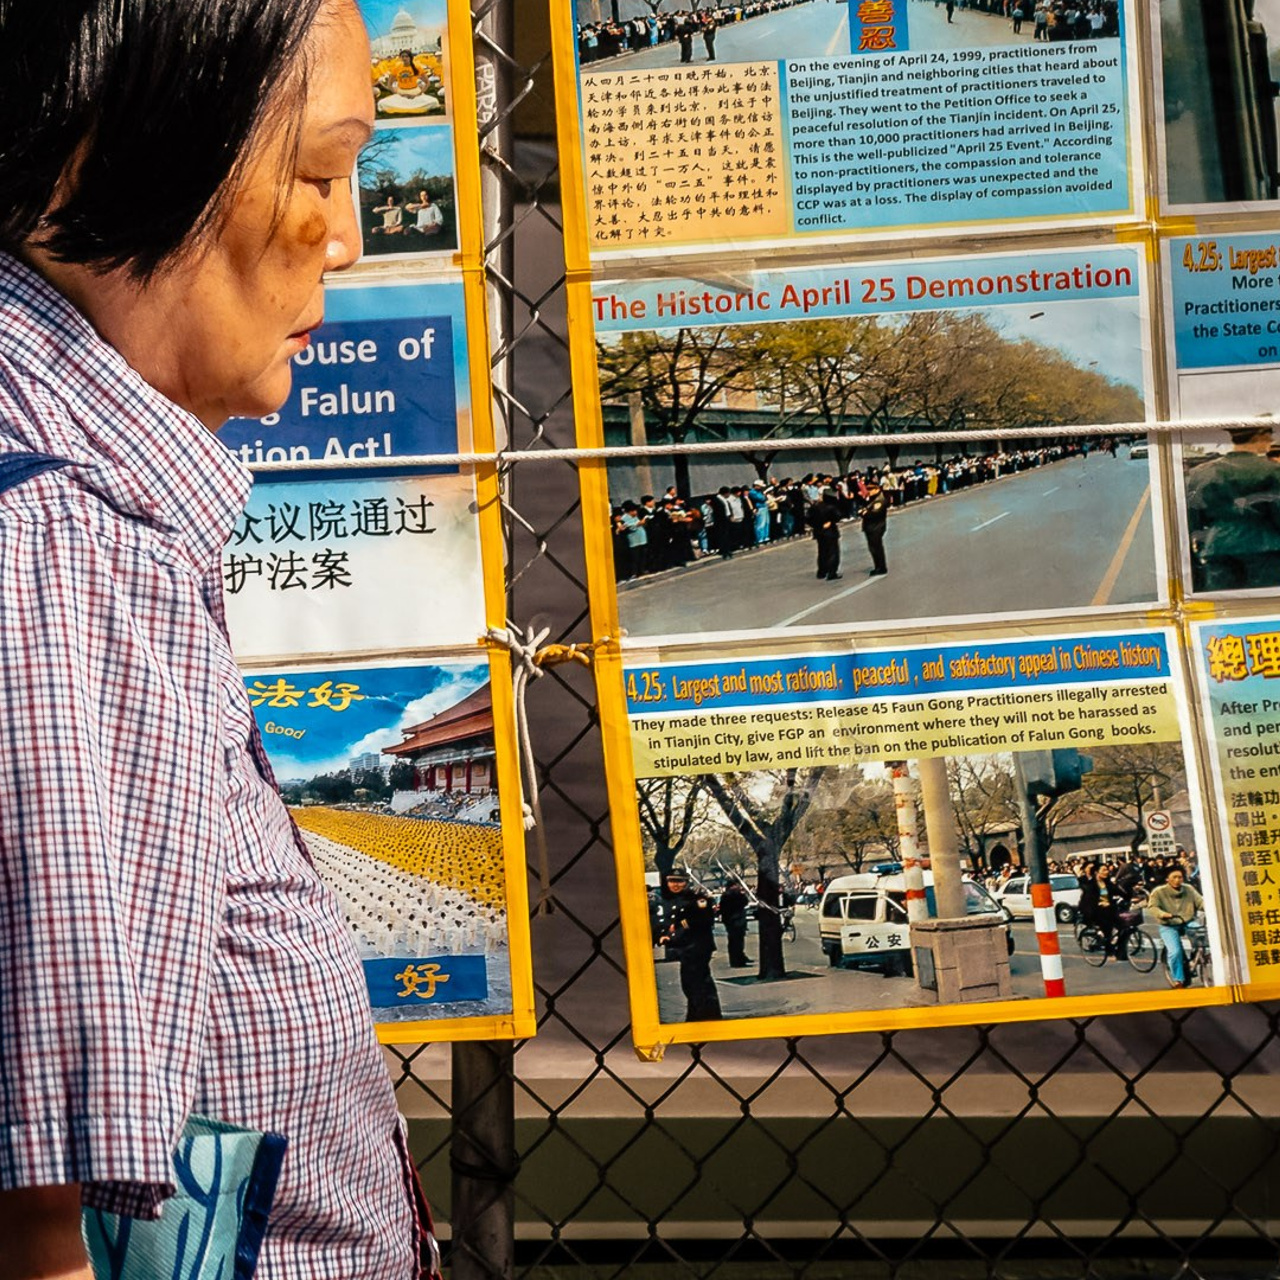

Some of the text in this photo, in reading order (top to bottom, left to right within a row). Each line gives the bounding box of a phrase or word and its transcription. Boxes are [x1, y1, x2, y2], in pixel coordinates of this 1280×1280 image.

[789, 44, 1097, 73] On the evening of April 24, 1999, practitioners from
[790, 57, 1118, 88] Beijing, Tianjin and neighboring cities that heard about
[1183, 241, 1277, 275] 4.25: Largest
[592, 263, 1132, 321] The Historic April 25 Demonstration
[1232, 275, 1273, 289] More
[1185, 299, 1280, 316] Practitioners
[1193, 324, 1218, 338] the
[1223, 323, 1262, 337] State
[288, 327, 436, 366] ouse of
[1258, 346, 1277, 358] on
[299, 384, 396, 417] Falun
[323, 433, 393, 461] Act!
[223, 547, 353, 595] 护法案
[627, 671, 667, 703] 4.25:
[672, 674, 721, 704] Largest
[722, 668, 747, 693] and
[749, 675, 784, 694] most
[922, 655, 944, 681] and
[950, 651, 1016, 680] satisfactory
[1019, 647, 1057, 678] appeal
[1060, 645, 1072, 671] in
[1073, 643, 1119, 670] Chinese
[1120, 640, 1162, 672] history
[632, 683, 1167, 732] They made three requests: Release 45 Faun Gong Practitioners illegally arrested
[1221, 700, 1258, 715] After
[264, 721, 306, 741] Good
[1224, 722, 1251, 737] and
[1230, 766, 1255, 780] the
[865, 934, 901, 949] 公安
[394, 962, 451, 999] 好
